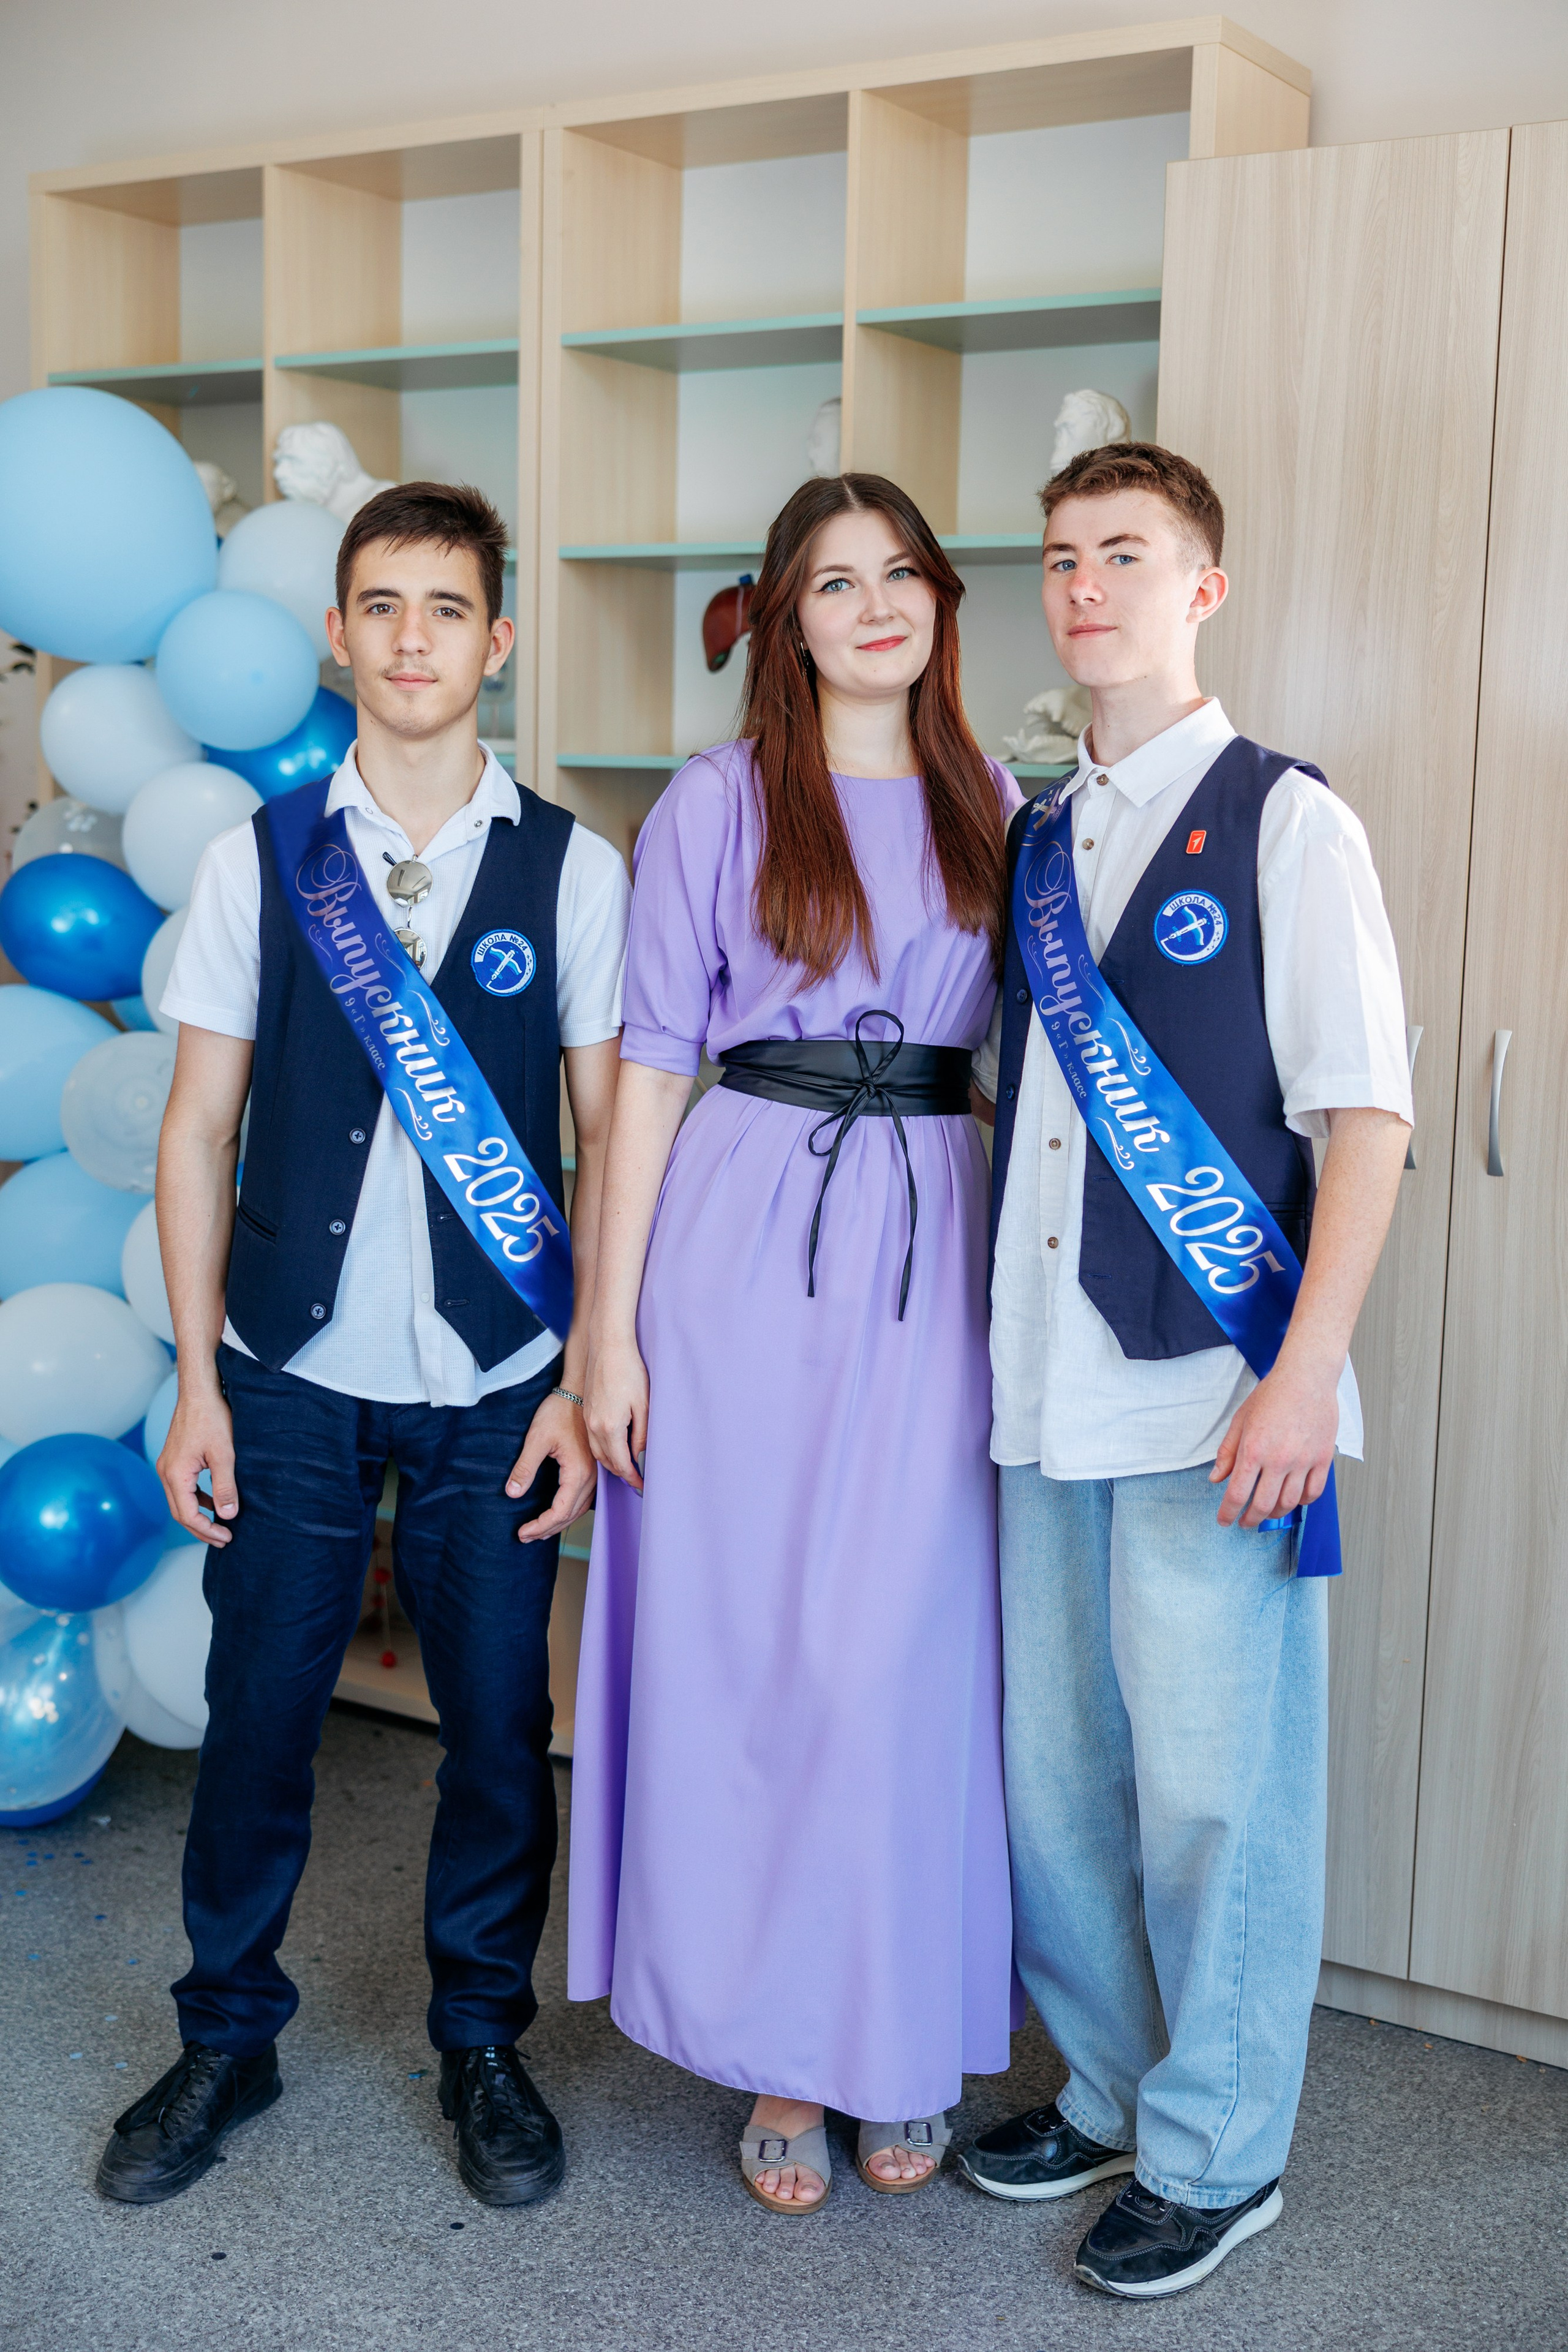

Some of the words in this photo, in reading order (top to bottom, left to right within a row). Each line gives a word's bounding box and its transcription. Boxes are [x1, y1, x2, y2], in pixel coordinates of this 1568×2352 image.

[1169, 896, 1205, 911] ШКОЛА
[477, 934, 507, 956] ШКОЛА
[510, 935, 528, 951] №24
[296, 843, 466, 1123] Выпускник
[443, 1137, 560, 1262] 2025
[345, 997, 355, 1006] 9
[363, 1035, 385, 1070] класс
[1023, 841, 1170, 1153] Выпускник
[1145, 1166, 1286, 1294] 2025
[1051, 1021, 1060, 1030] 9
[1066, 1061, 1087, 1099] класс
